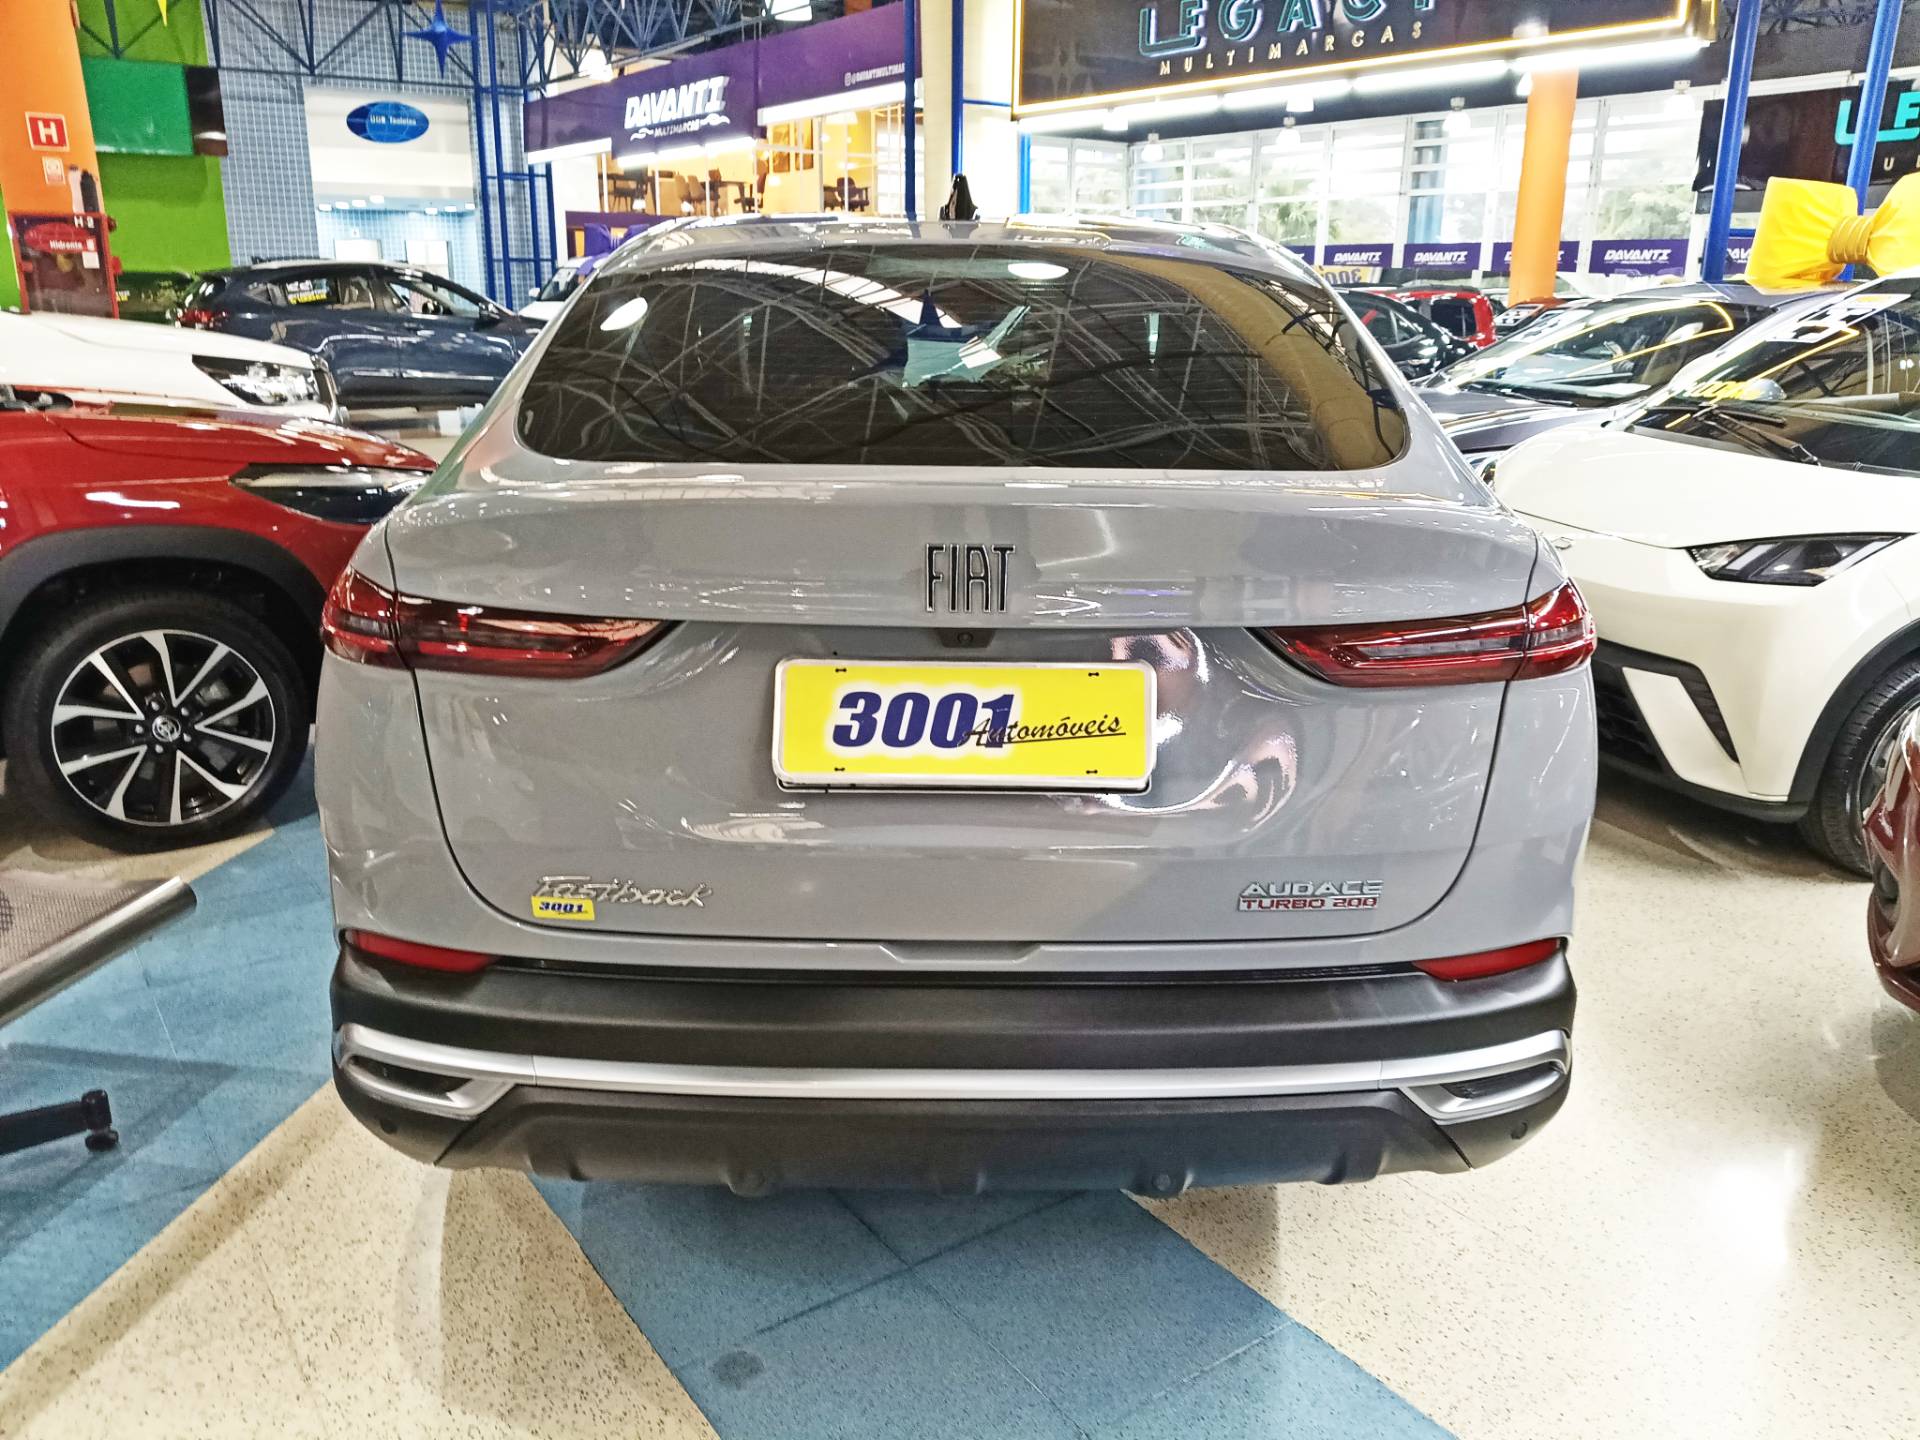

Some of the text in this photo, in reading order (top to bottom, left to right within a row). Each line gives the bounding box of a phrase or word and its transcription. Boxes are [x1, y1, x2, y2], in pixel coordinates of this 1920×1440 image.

[1139, 0, 1435, 56] LEGAC
[1159, 21, 1422, 76] MULTIMARCAS
[624, 76, 730, 129] DAVANTI
[37, 119, 58, 144] H
[1334, 251, 1383, 262] DAVANTI
[1413, 251, 1468, 262] DAVANTI
[1604, 249, 1672, 261] DAVANTI
[926, 544, 1016, 612] FIAT
[832, 691, 1015, 748] 3001
[957, 714, 1126, 746] Automóveis
[535, 875, 713, 908] Fastback
[1240, 879, 1384, 896] AUDACE
[538, 902, 583, 913] 3001
[1241, 897, 1378, 909] TURBO 200
